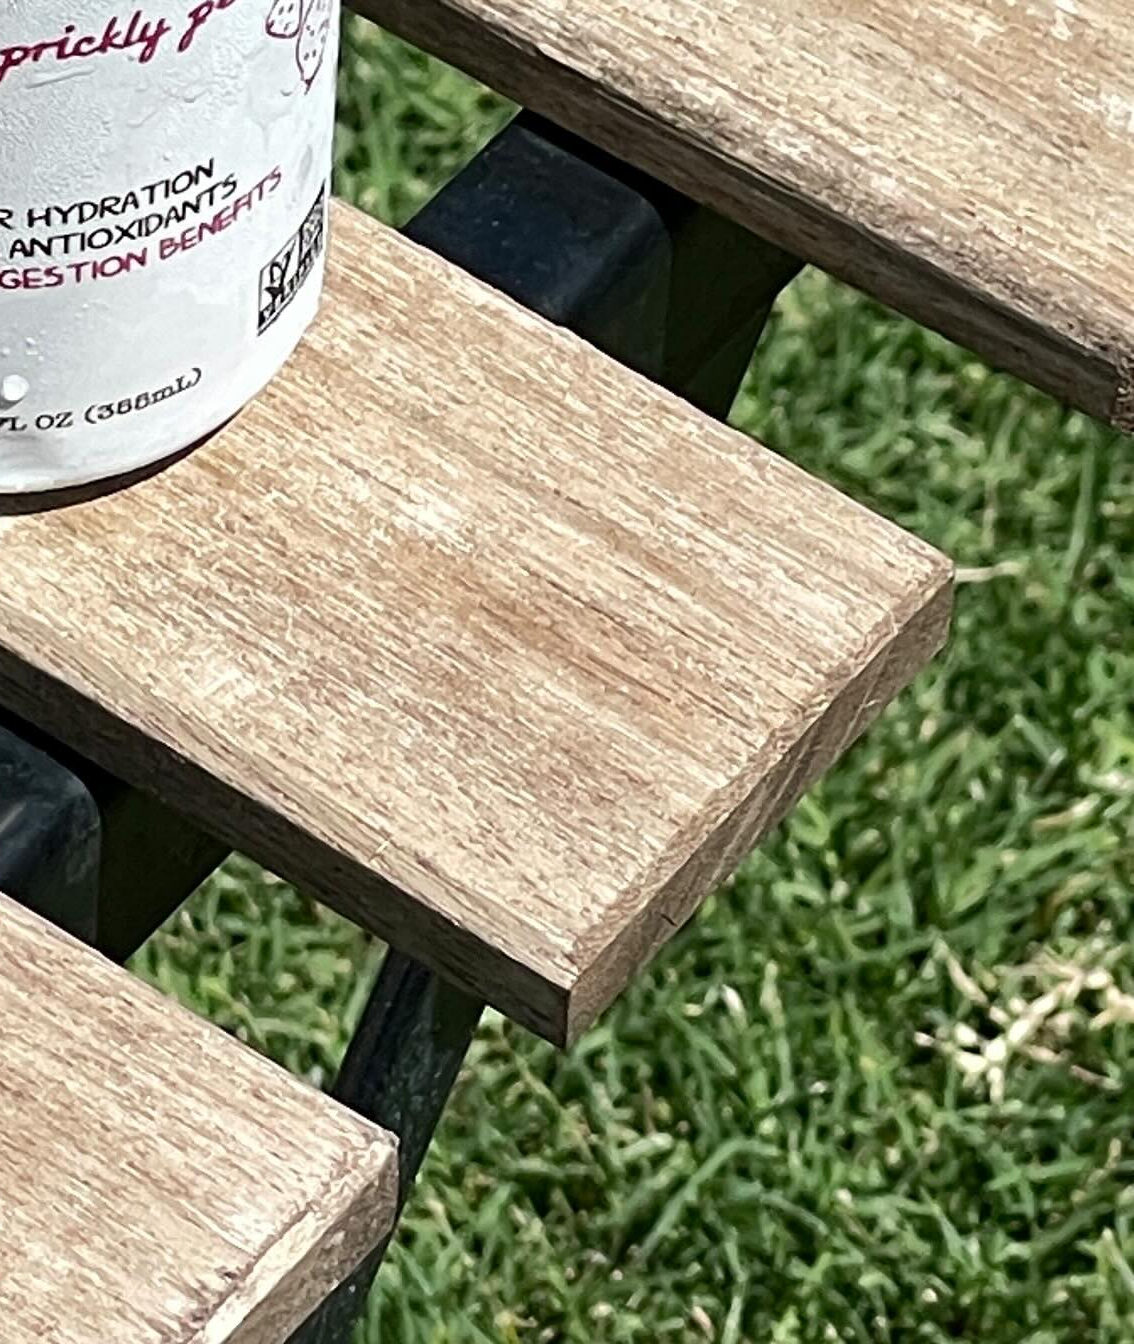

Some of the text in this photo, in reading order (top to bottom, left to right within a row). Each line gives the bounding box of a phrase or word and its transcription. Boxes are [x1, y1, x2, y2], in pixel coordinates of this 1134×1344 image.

[9, 172, 238, 260] ANTIOXIDANTS
[26, 157, 215, 229] HYDRATION
[158, 164, 283, 261] BENEFITS
[35, 411, 75, 431] OZ
